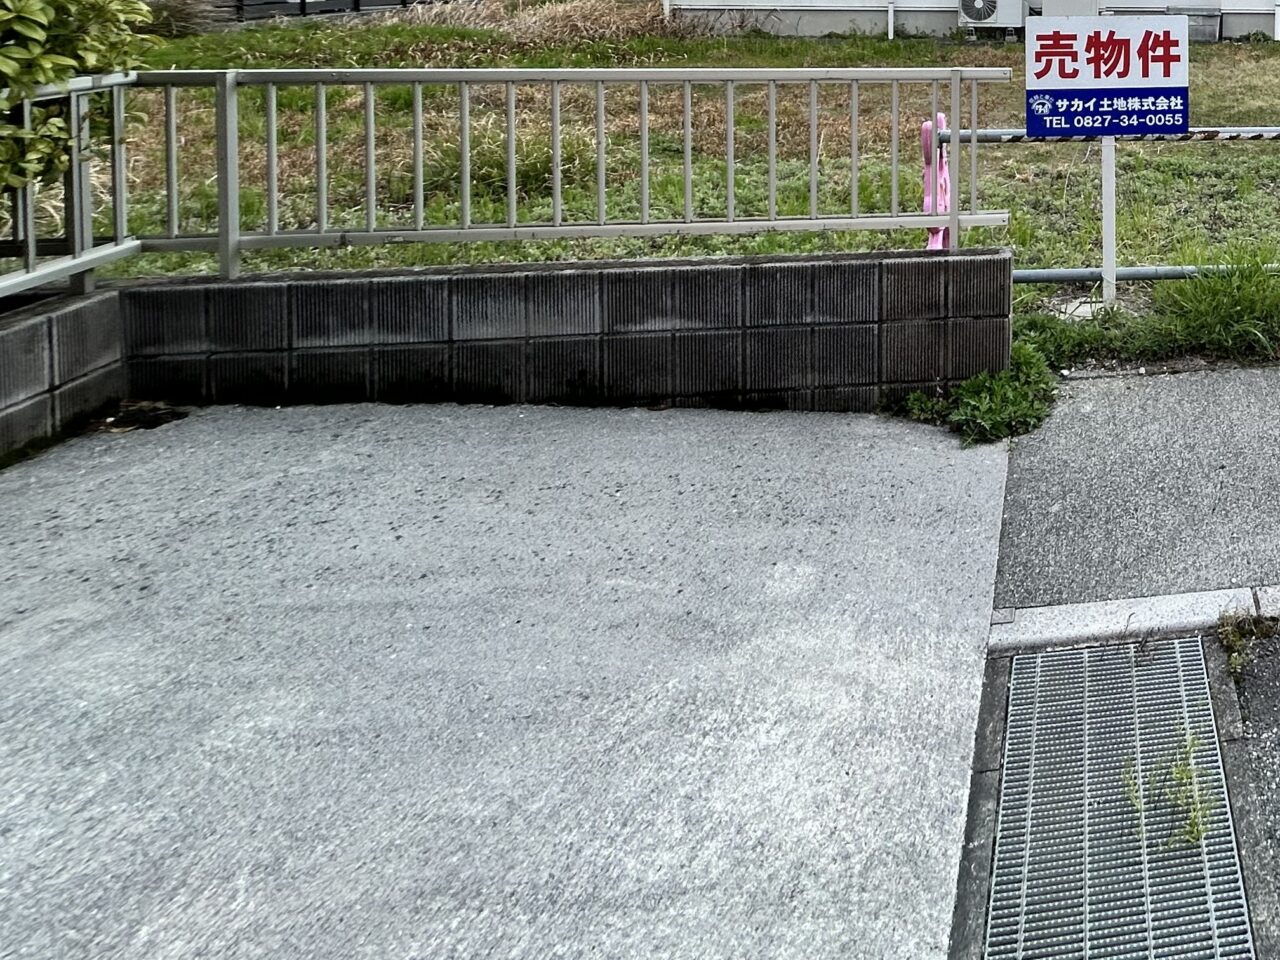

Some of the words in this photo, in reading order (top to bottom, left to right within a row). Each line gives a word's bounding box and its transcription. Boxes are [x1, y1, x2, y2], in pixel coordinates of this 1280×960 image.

[1034, 30, 1181, 80] 売物件
[1055, 96, 1184, 113] サカイ土地株式会社
[1043, 116, 1070, 128] TEL
[1073, 113, 1183, 128] 0827-34-0055
